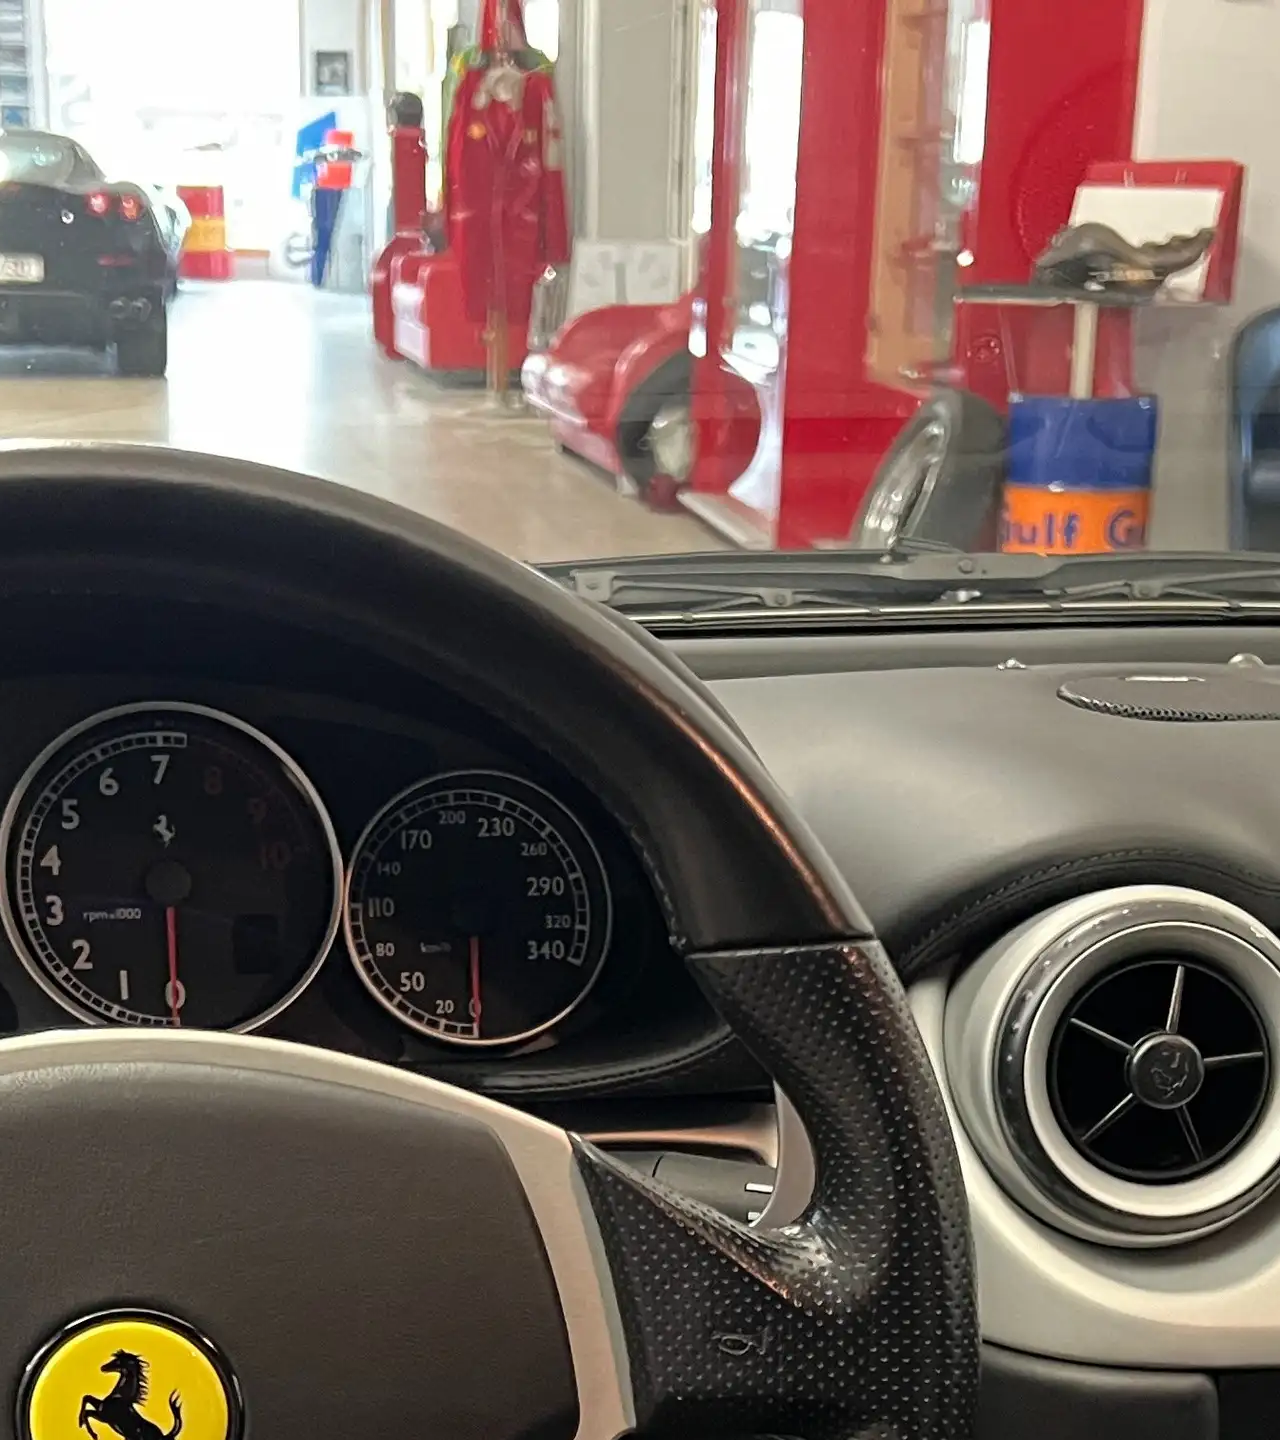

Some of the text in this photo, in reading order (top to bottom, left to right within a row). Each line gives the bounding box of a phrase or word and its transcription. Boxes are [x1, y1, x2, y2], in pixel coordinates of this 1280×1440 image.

[150, 754, 170, 785] 7
[99, 767, 119, 796] 6
[61, 799, 80, 830] 5
[438, 810, 466, 825] 200
[477, 817, 515, 838] 230
[400, 829, 432, 850] 170
[521, 842, 548, 857] 260
[40, 844, 61, 875] 4
[376, 861, 401, 876] 140
[526, 876, 565, 897] 290
[45, 895, 64, 926] 3
[367, 898, 395, 918] 110
[545, 914, 571, 929] 320
[71, 939, 94, 970] 2
[375, 942, 395, 957] 80
[527, 941, 565, 960] 340
[118, 969, 130, 1001] 1
[400, 971, 425, 992] 50
[164, 980, 187, 1010] 0
[435, 999, 455, 1014] 20
